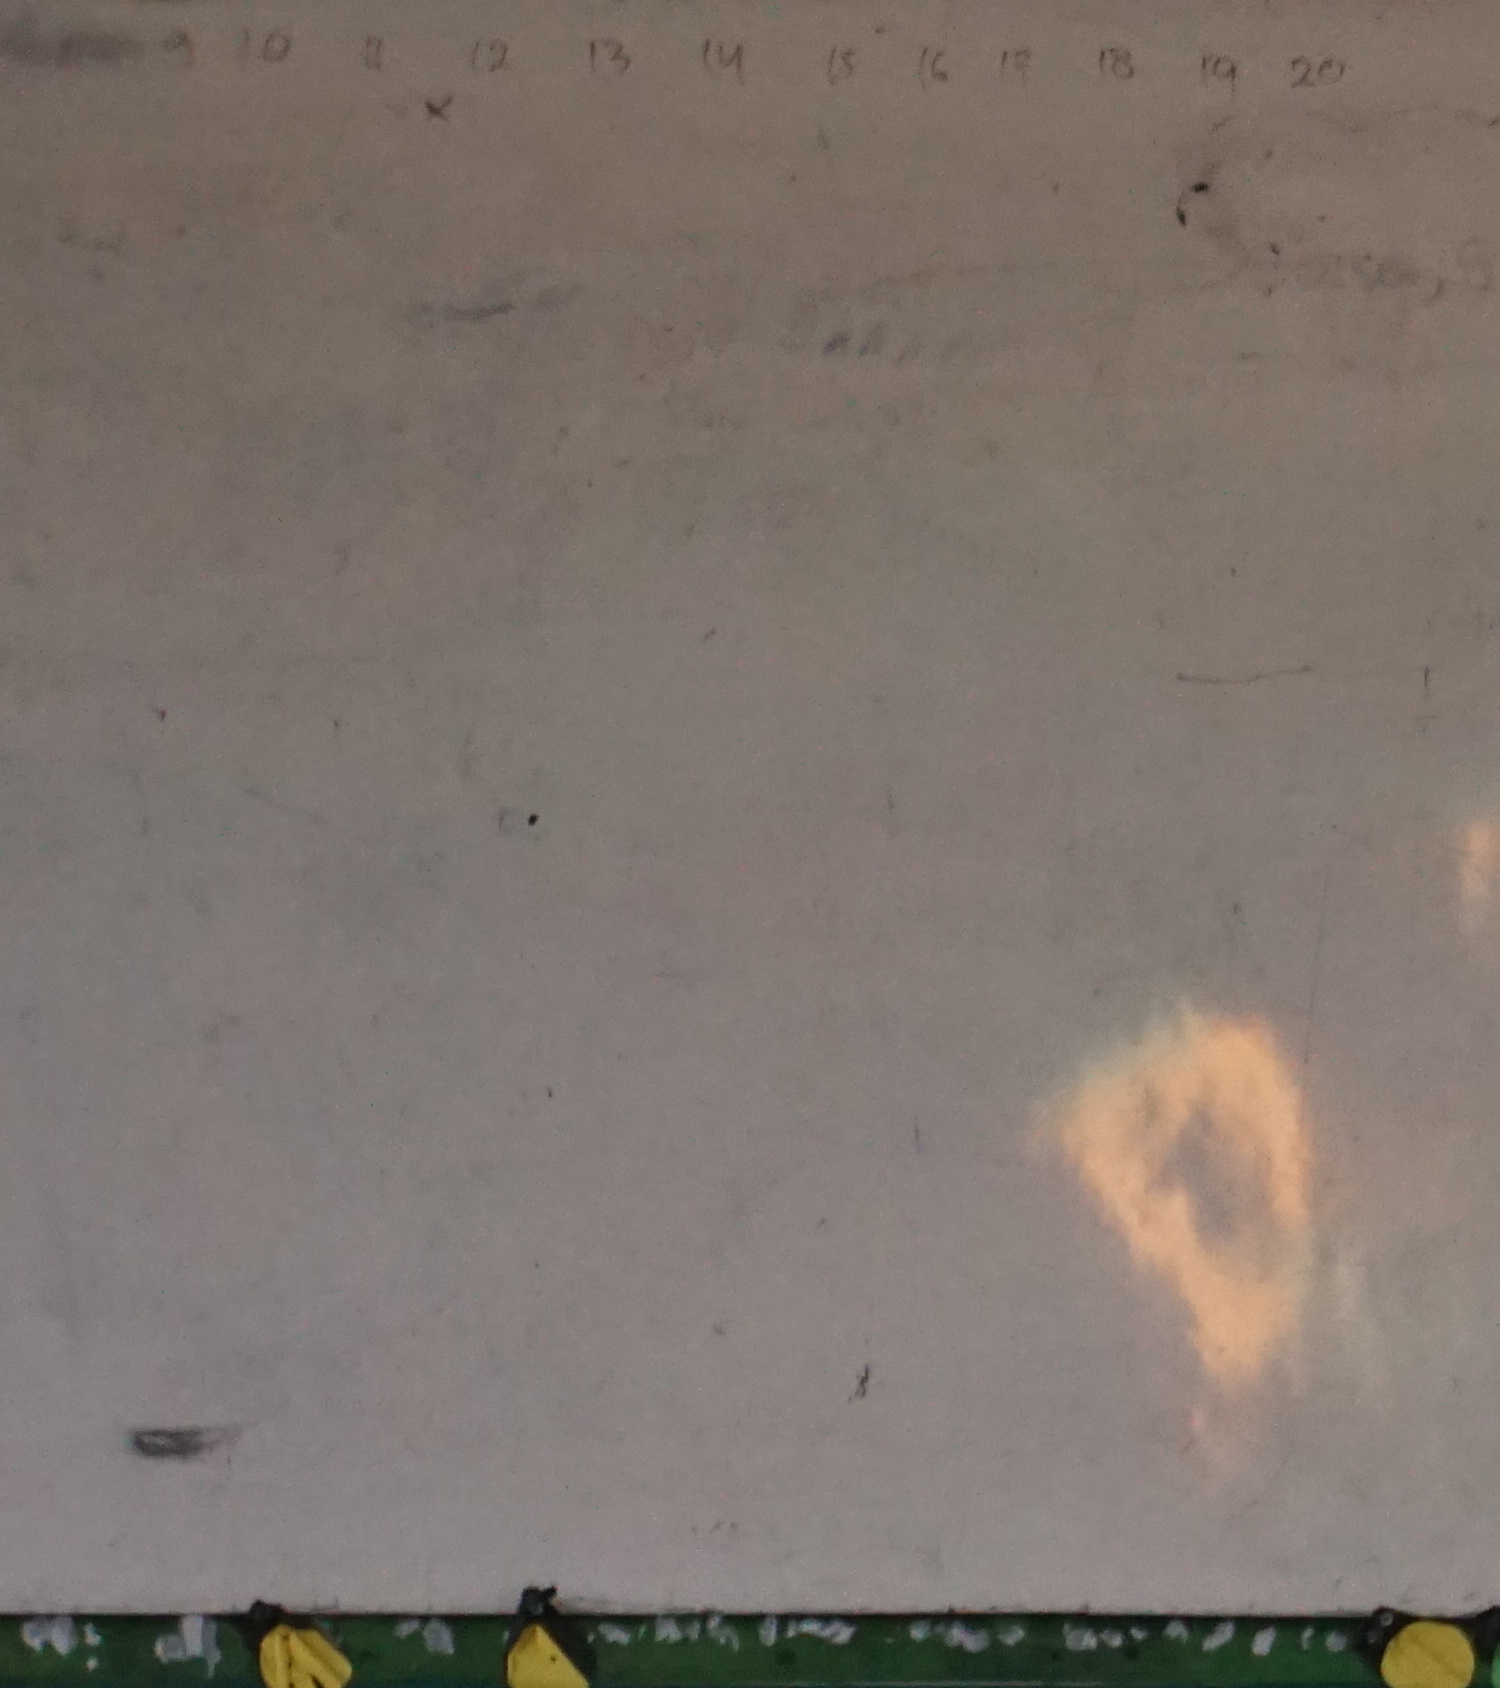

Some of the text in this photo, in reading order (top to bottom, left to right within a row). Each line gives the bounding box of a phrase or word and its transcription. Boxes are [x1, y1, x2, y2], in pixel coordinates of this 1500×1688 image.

[469, 37, 508, 75] 12
[589, 39, 631, 76] 13
[702, 38, 746, 86] 14
[826, 41, 859, 86] 15
[918, 44, 950, 91] 16
[1099, 45, 1136, 84] 18
[1200, 52, 1239, 96] 19
[1289, 54, 1346, 89] 20
